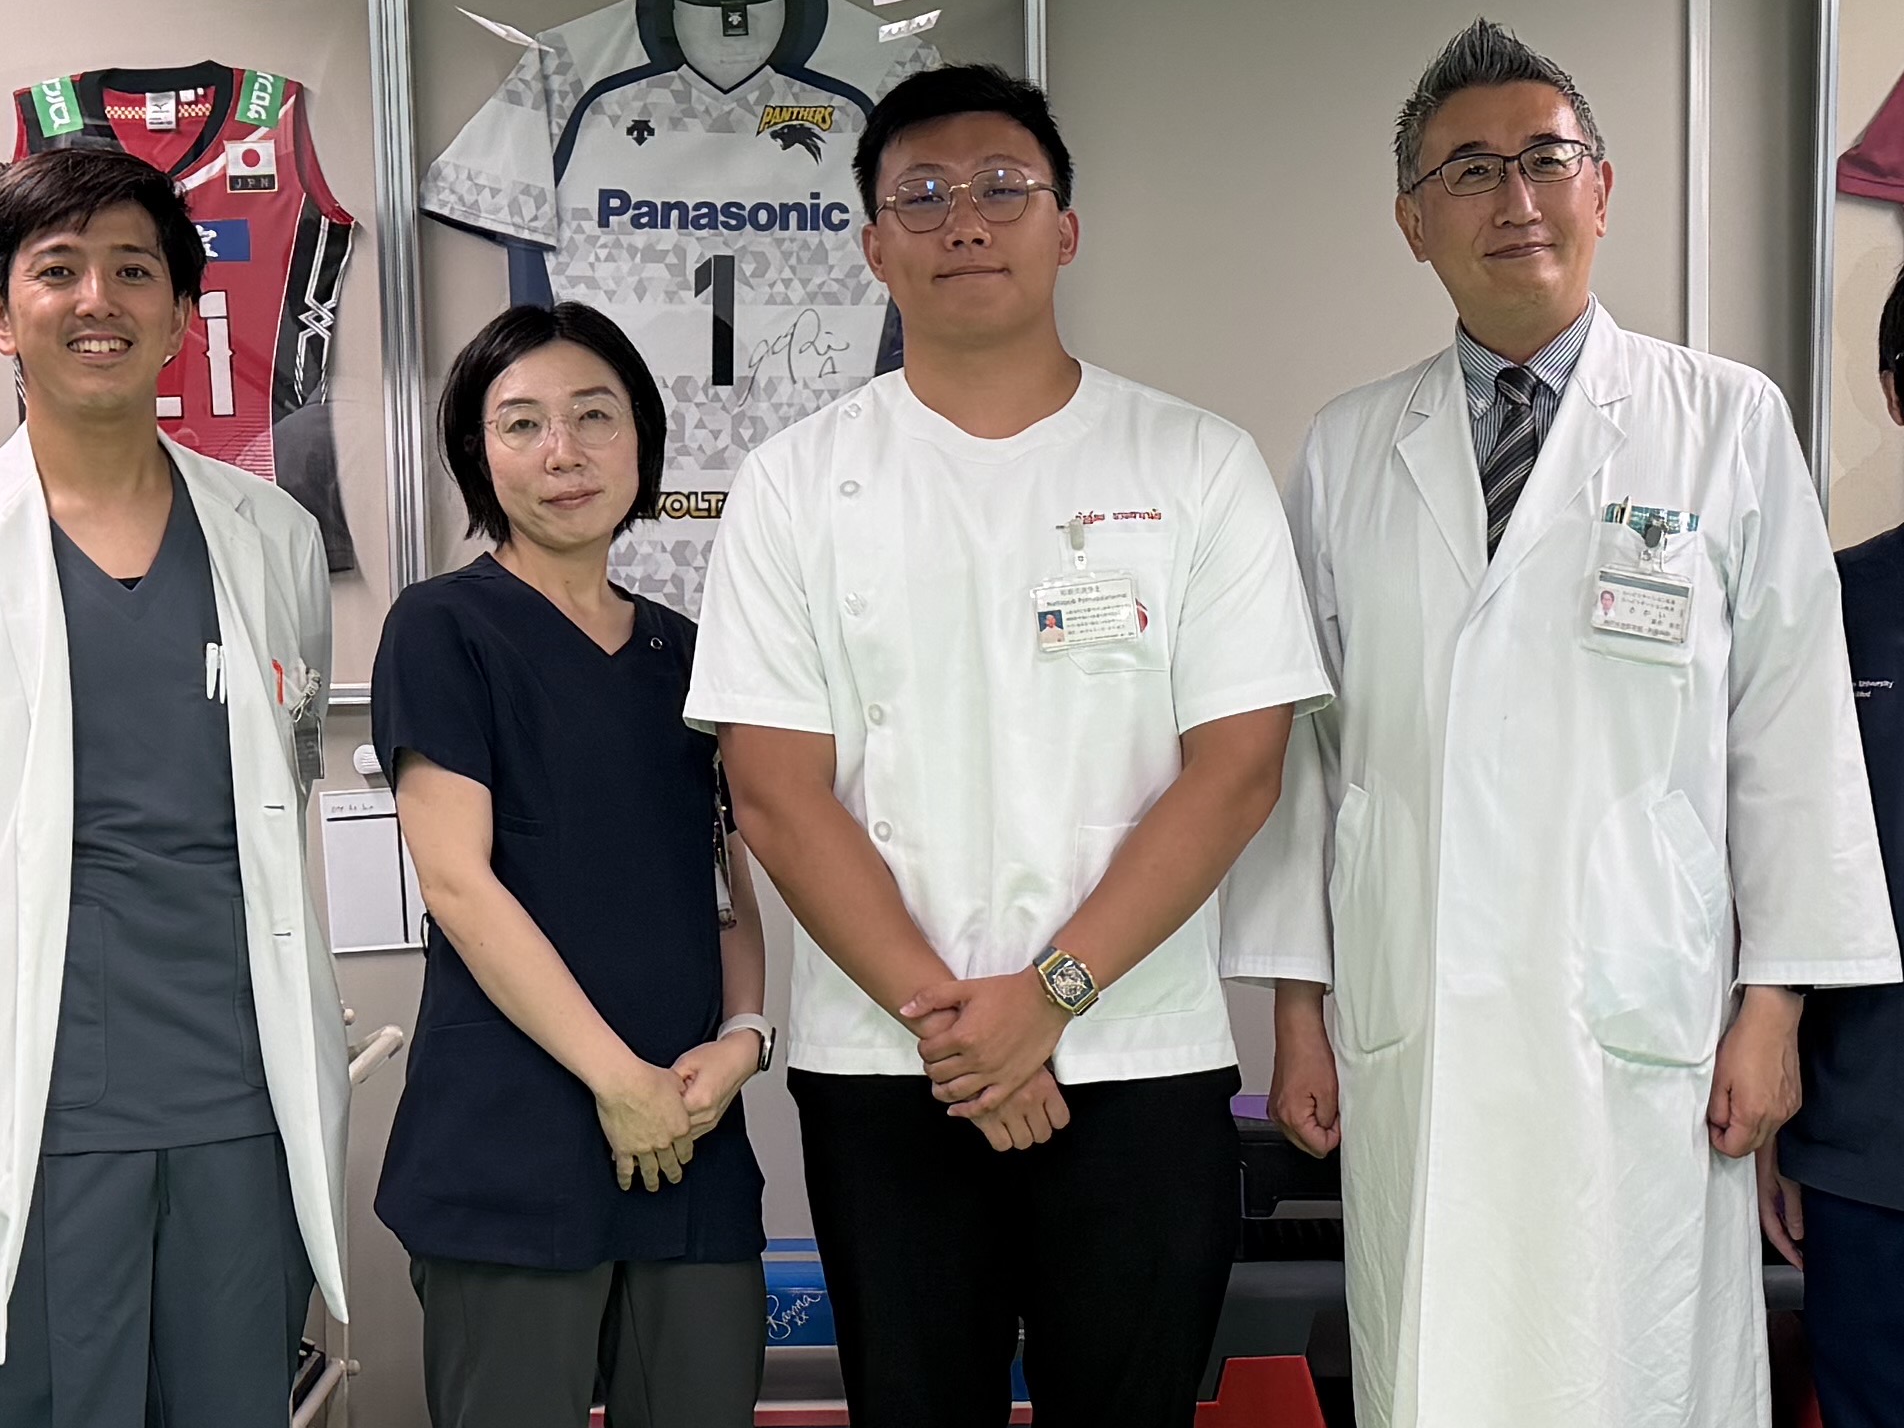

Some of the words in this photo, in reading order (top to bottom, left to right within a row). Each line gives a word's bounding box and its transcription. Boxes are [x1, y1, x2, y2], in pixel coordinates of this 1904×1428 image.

[756, 104, 836, 137] PANTHERS
[235, 176, 270, 189] JPN
[597, 188, 851, 232] Panasonic
[693, 254, 735, 387] 1
